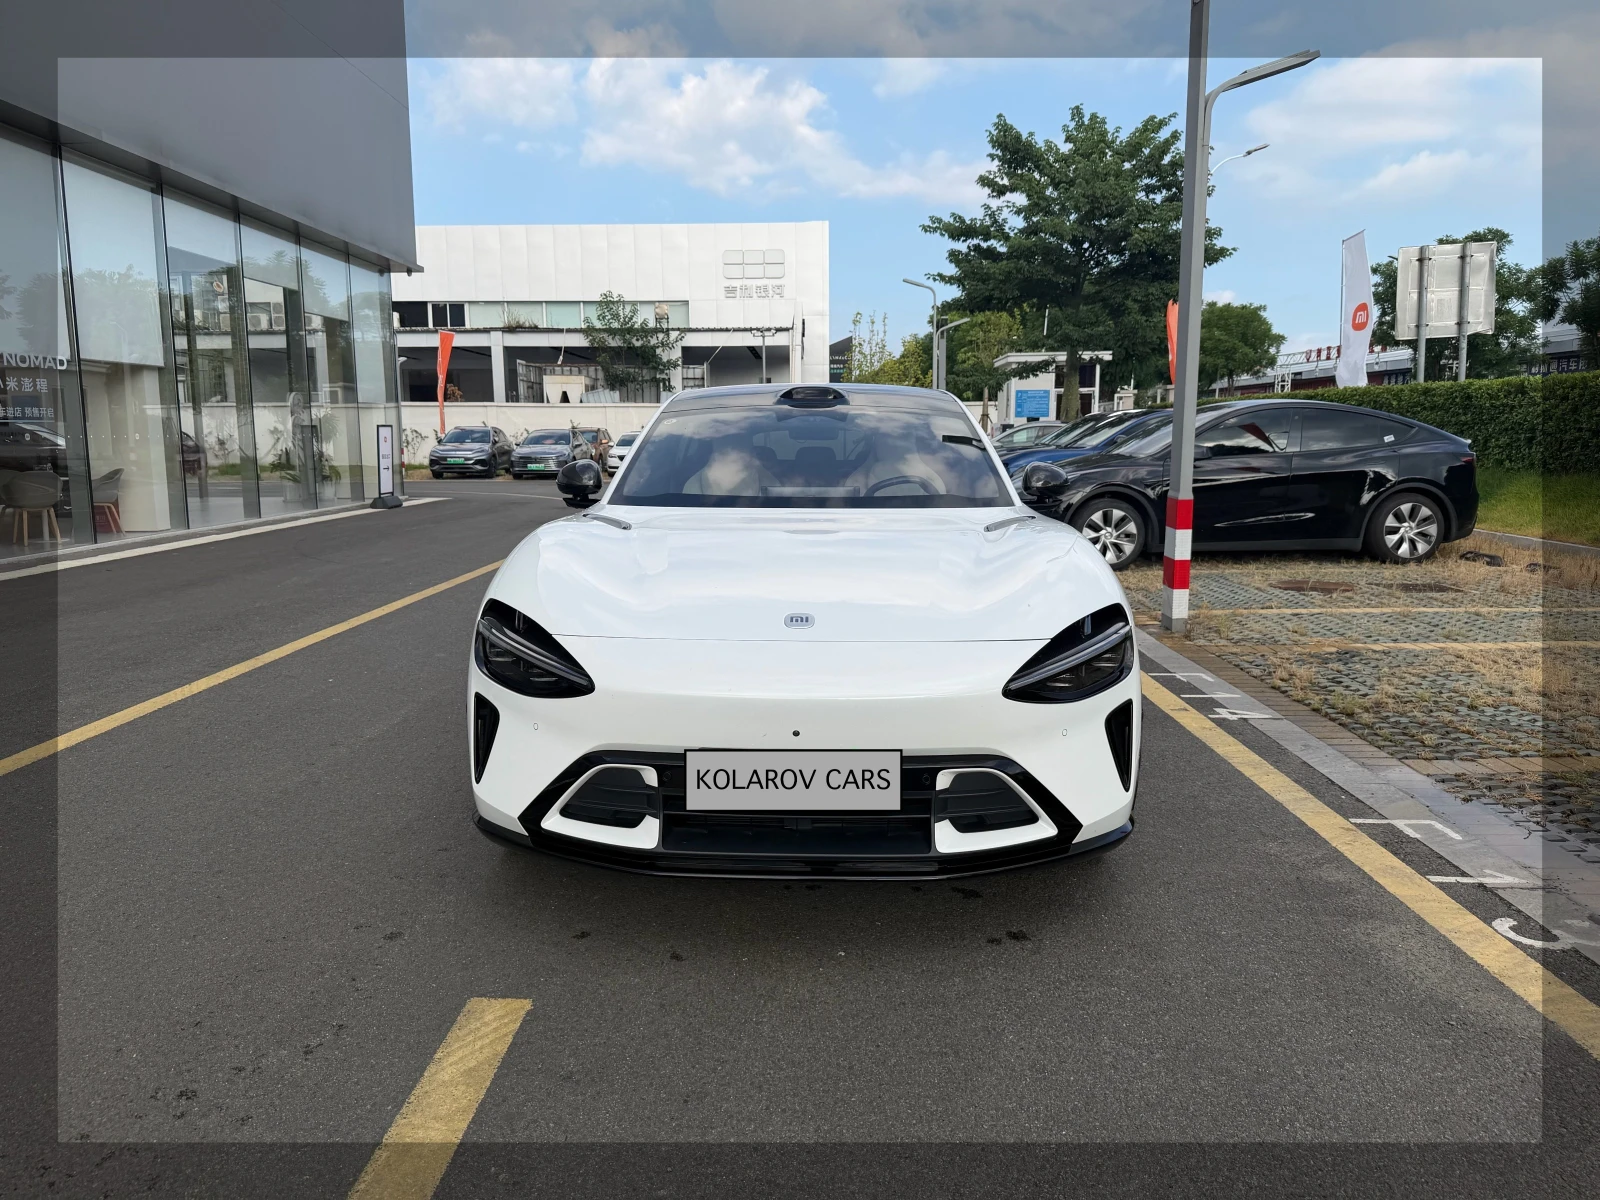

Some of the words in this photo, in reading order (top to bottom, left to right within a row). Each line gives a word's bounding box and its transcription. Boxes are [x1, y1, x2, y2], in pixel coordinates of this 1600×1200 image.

[723, 284, 785, 299] 吉利银河
[25, 406, 54, 418] 预售开启
